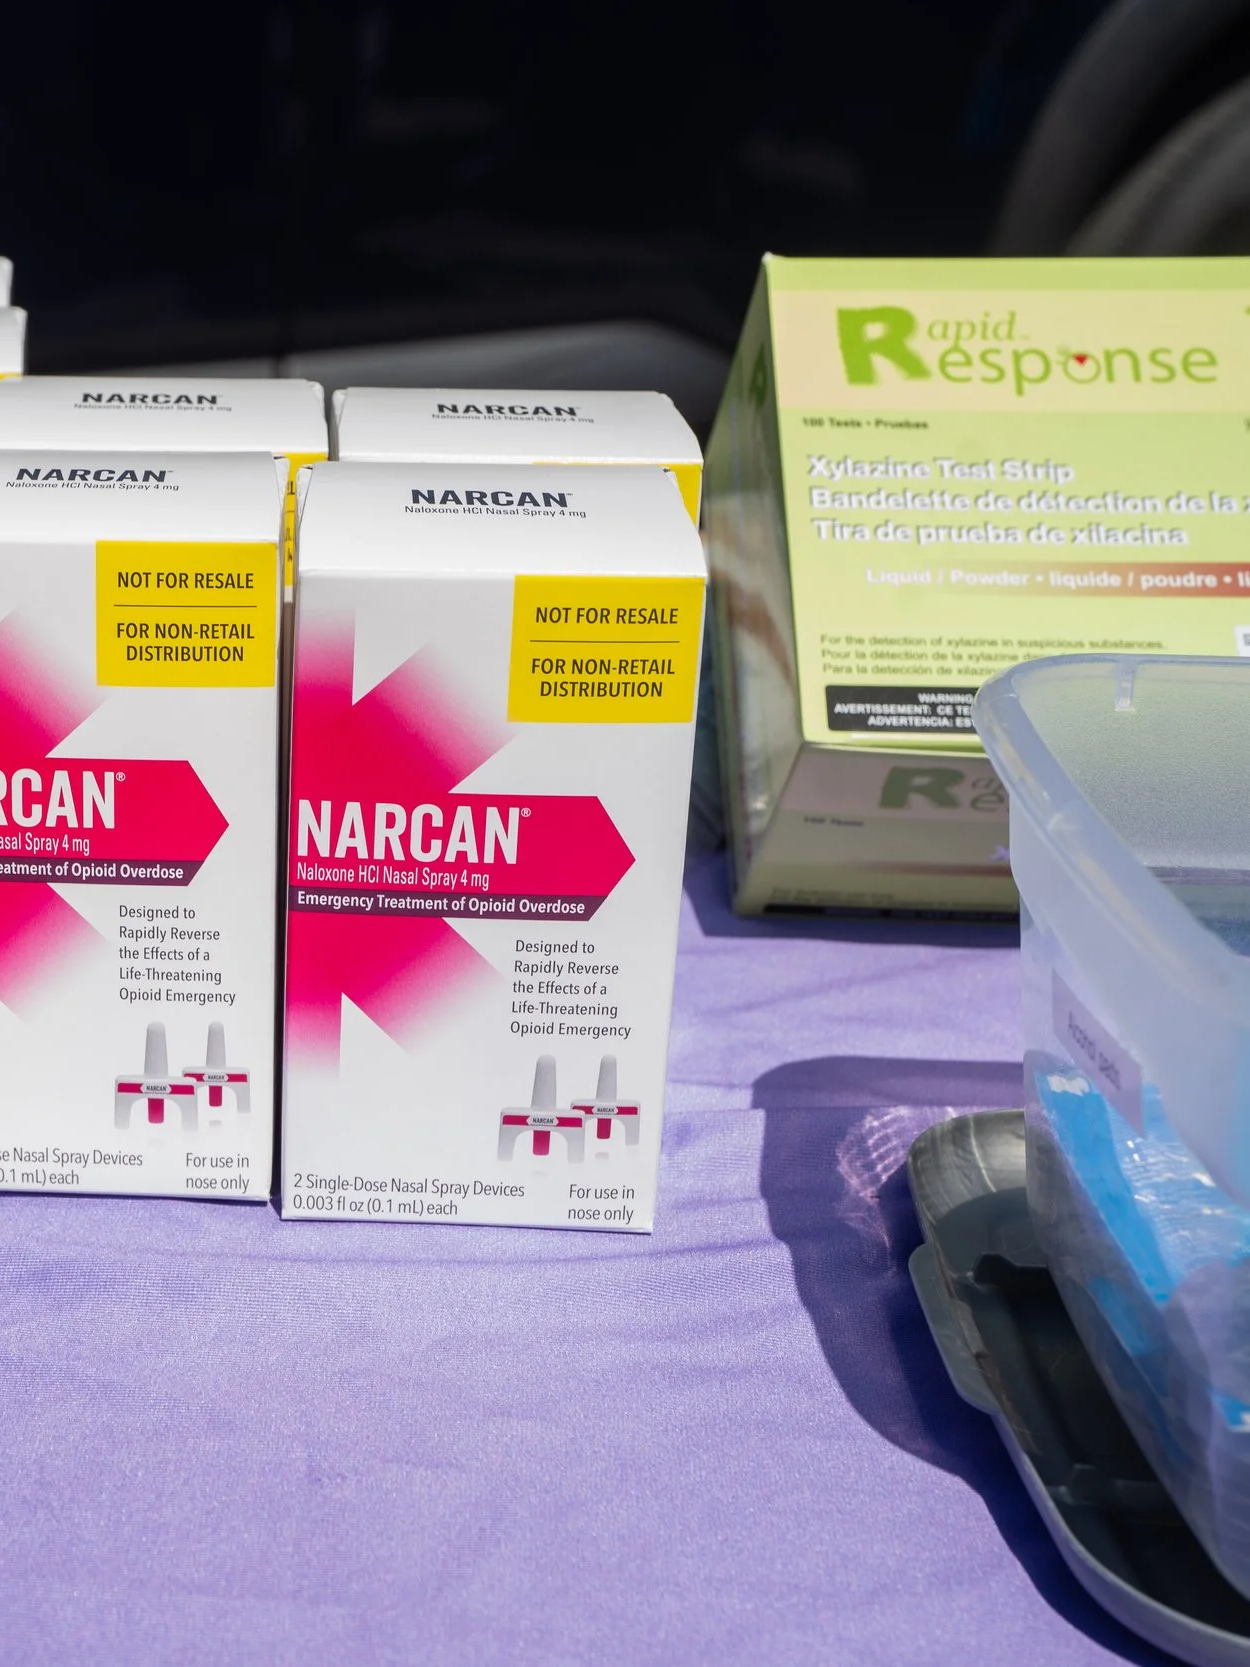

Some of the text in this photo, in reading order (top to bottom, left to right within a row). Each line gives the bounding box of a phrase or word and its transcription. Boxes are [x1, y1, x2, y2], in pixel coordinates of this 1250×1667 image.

[807, 455, 1075, 484] Xylazine Test Strip
[6, 481, 58, 489] Naloxone
[84, 482, 115, 490] Nasal
[118, 483, 151, 491] Spray
[809, 486, 1238, 514] Bandelette de détection de la
[812, 517, 1189, 546] Tira de prueba de xilacina
[117, 573, 254, 590] NOT FOR RESALE
[865, 568, 1218, 591] Liquid Powder liquide poudre
[535, 607, 679, 625] NOT FOR RESALE
[116, 623, 255, 640] FOR NON-RETAIL
[820, 634, 1164, 650] For the detection of xylazine in suspicious substances.
[125, 645, 244, 663] DISTRIBUTION
[531, 658, 676, 676] FOR NON-RETAIL
[539, 680, 663, 699] DISTRIBUTION
[25, 834, 60, 855] Spray
[62, 836, 70, 852] 4
[71, 840, 91, 856] mg
[54, 860, 69, 877] of
[71, 862, 117, 881] Opioid
[120, 863, 184, 880] Overdose
[297, 890, 585, 916] Emergency Treatment of Opioid Overdose
[119, 904, 196, 922] Designed to
[119, 925, 220, 943] Rapidly Reverse
[118, 945, 211, 962] the Effects of a
[119, 967, 222, 986] Life-Threatening
[119, 987, 236, 1006] Opioid Emergency
[13, 1147, 49, 1163] Nasal
[53, 1148, 89, 1168] Spray
[93, 1150, 143, 1166] Devices
[186, 1153, 250, 1168] For use in
[20, 1167, 47, 1186] mL)
[49, 1169, 80, 1185] each
[186, 1174, 250, 1194] nose only
